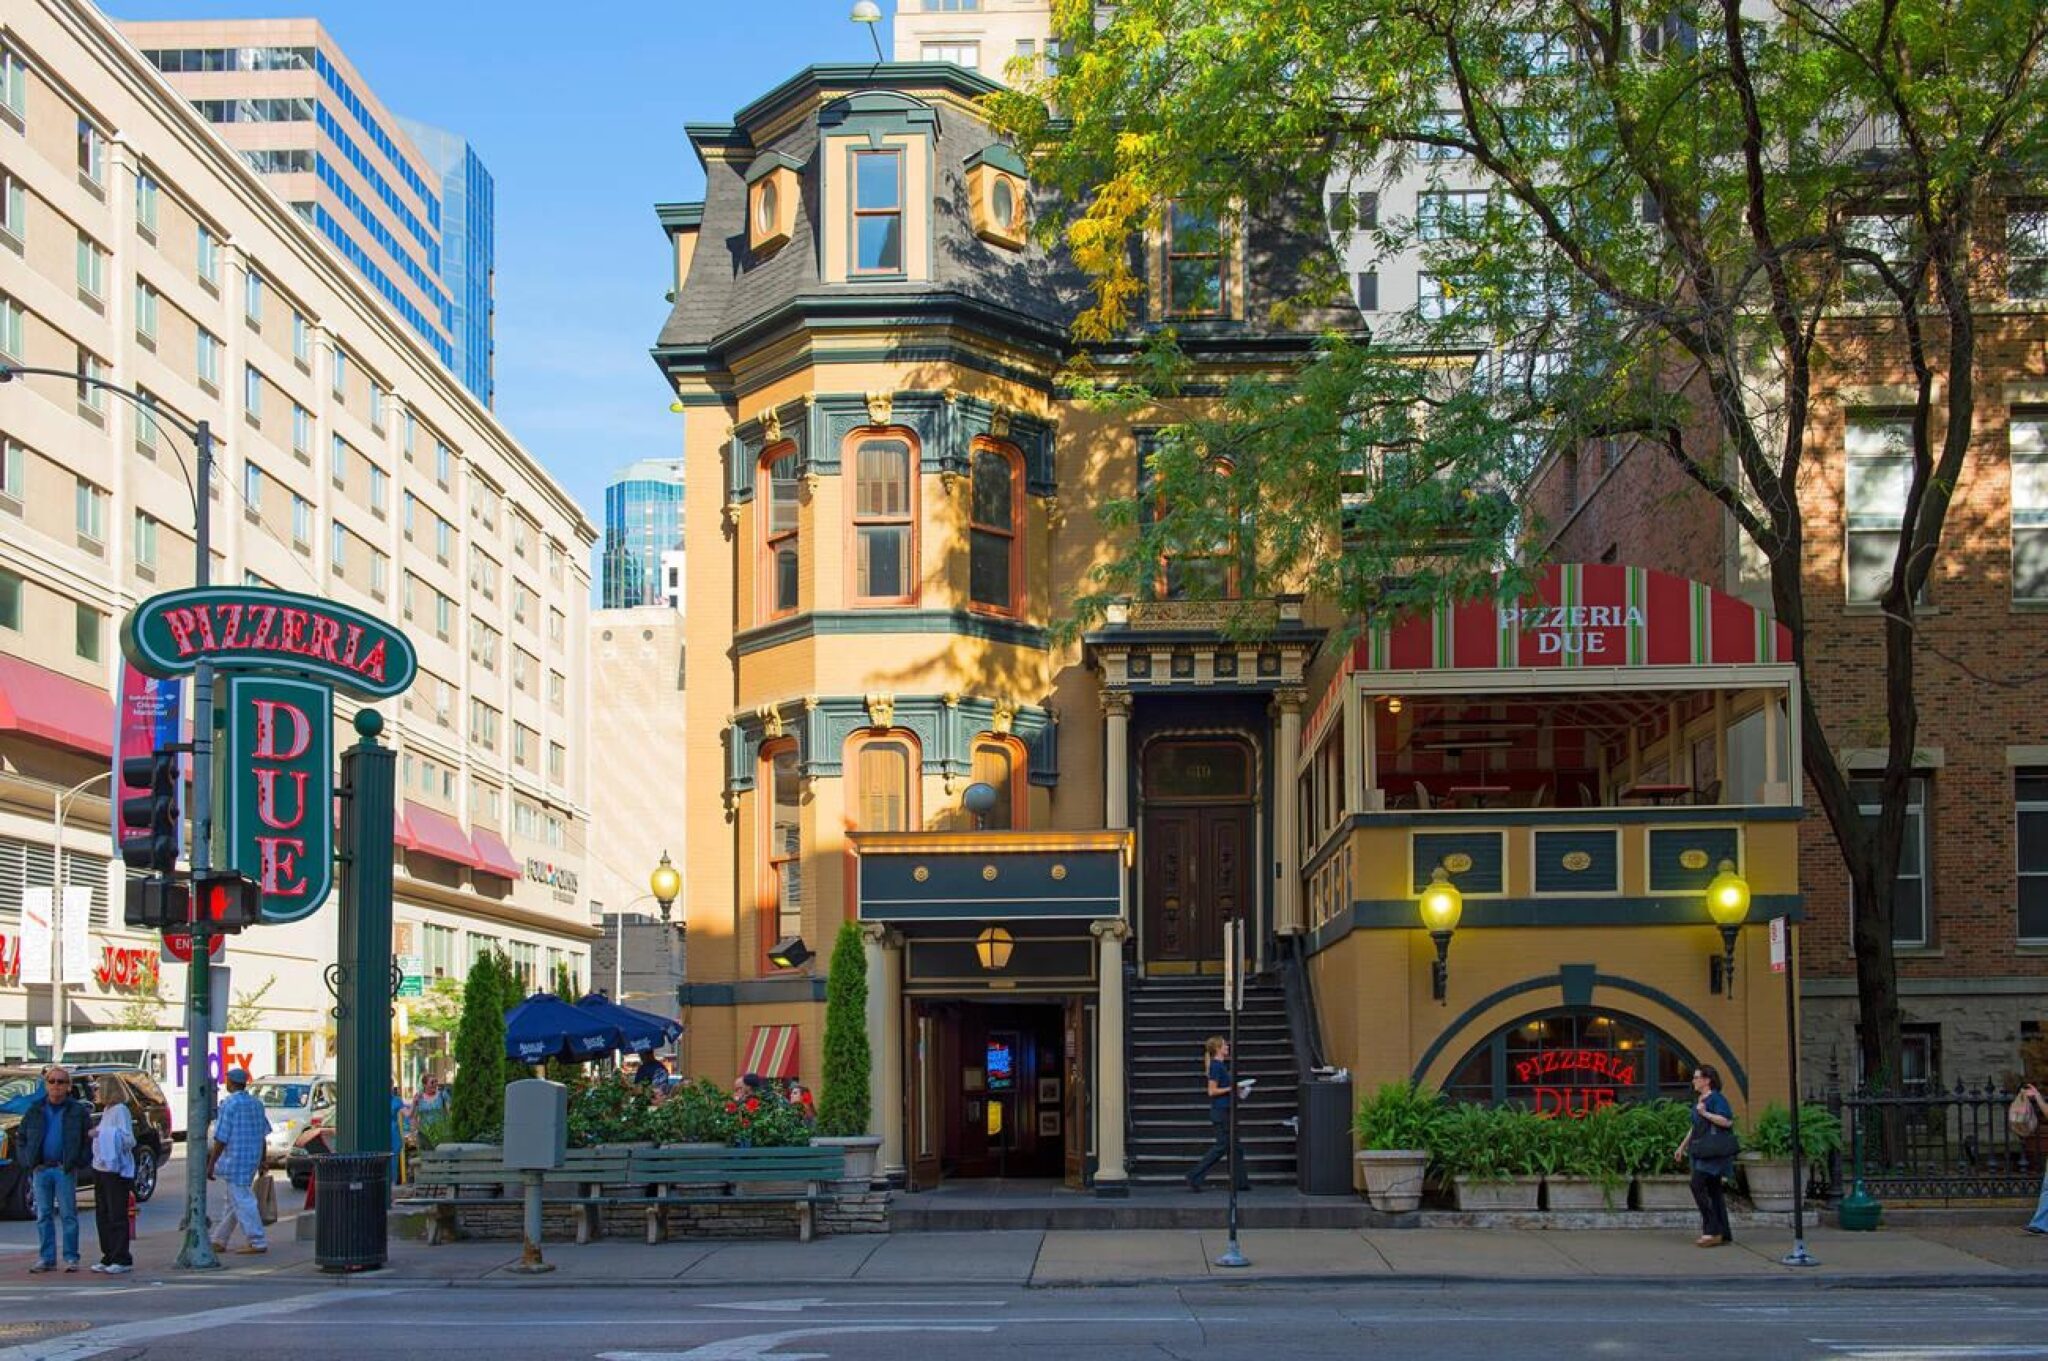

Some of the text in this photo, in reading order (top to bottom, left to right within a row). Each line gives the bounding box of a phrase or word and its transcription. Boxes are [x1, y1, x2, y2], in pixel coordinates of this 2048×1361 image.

[160, 603, 386, 683] PIZZERIA
[1538, 632, 1606, 654] DUE
[251, 699, 312, 896] DUE
[175, 1035, 254, 1087] FdEx
[1515, 1049, 1635, 1086] PIZZERIA
